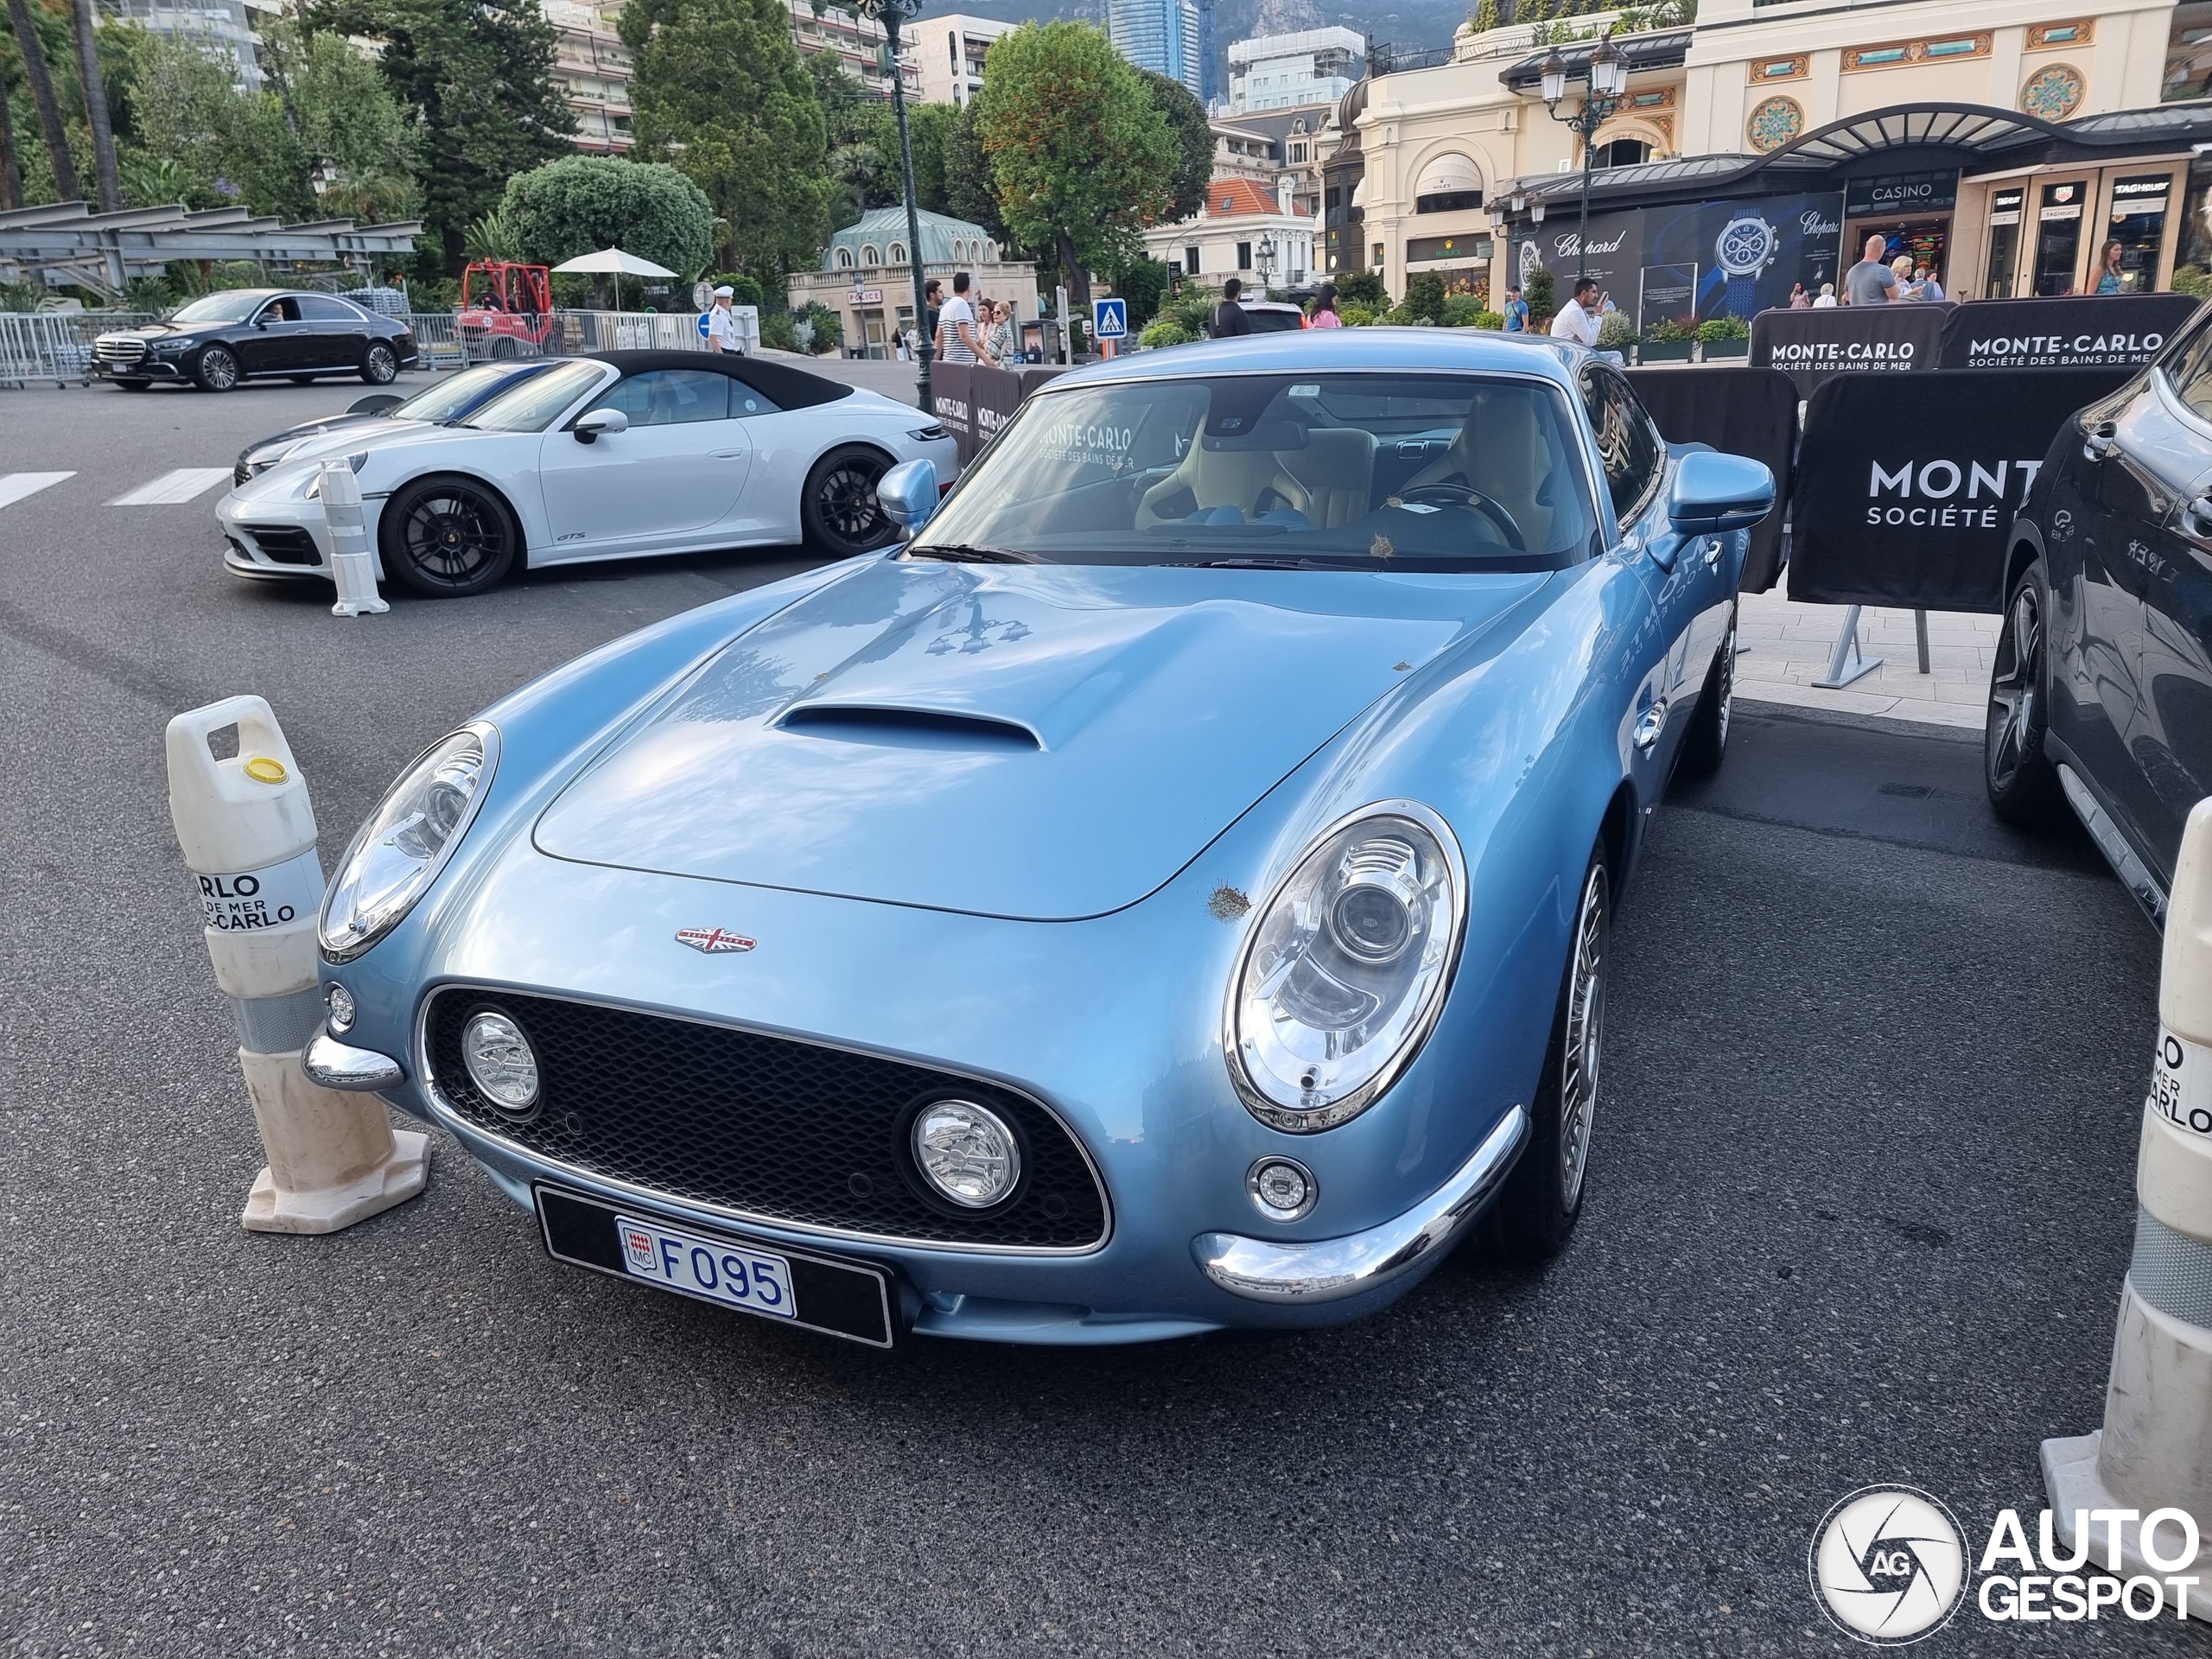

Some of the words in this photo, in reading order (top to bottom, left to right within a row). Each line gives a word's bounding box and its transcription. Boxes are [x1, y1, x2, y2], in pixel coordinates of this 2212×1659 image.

[1872, 184, 1932, 200] CASINO
[1554, 230, 1626, 257] Chpard
[1771, 360, 1812, 371] SOCIÉTÉ
[1815, 362, 1835, 371] DES
[1839, 361, 1869, 371] BAINS
[1873, 361, 1886, 370] DE
[1891, 361, 1911, 371] MER
[1968, 355, 2025, 367] SOCIÉTÉ
[2031, 356, 2056, 365] DES
[2061, 355, 2102, 365] BAINS
[2107, 354, 2126, 364] DE
[2131, 353, 2156, 363] ME
[1068, 450, 1081, 462] DES
[1083, 453, 1103, 465] BAINS
[1106, 454, 1116, 466] DE
[1867, 504, 1998, 528] SOCIÉTÉ
[557, 531, 586, 541] GTS
[198, 875, 260, 899] RLO
[207, 901, 222, 912] DE
[228, 899, 266, 913] MER
[633, 1250, 652, 1266] MC
